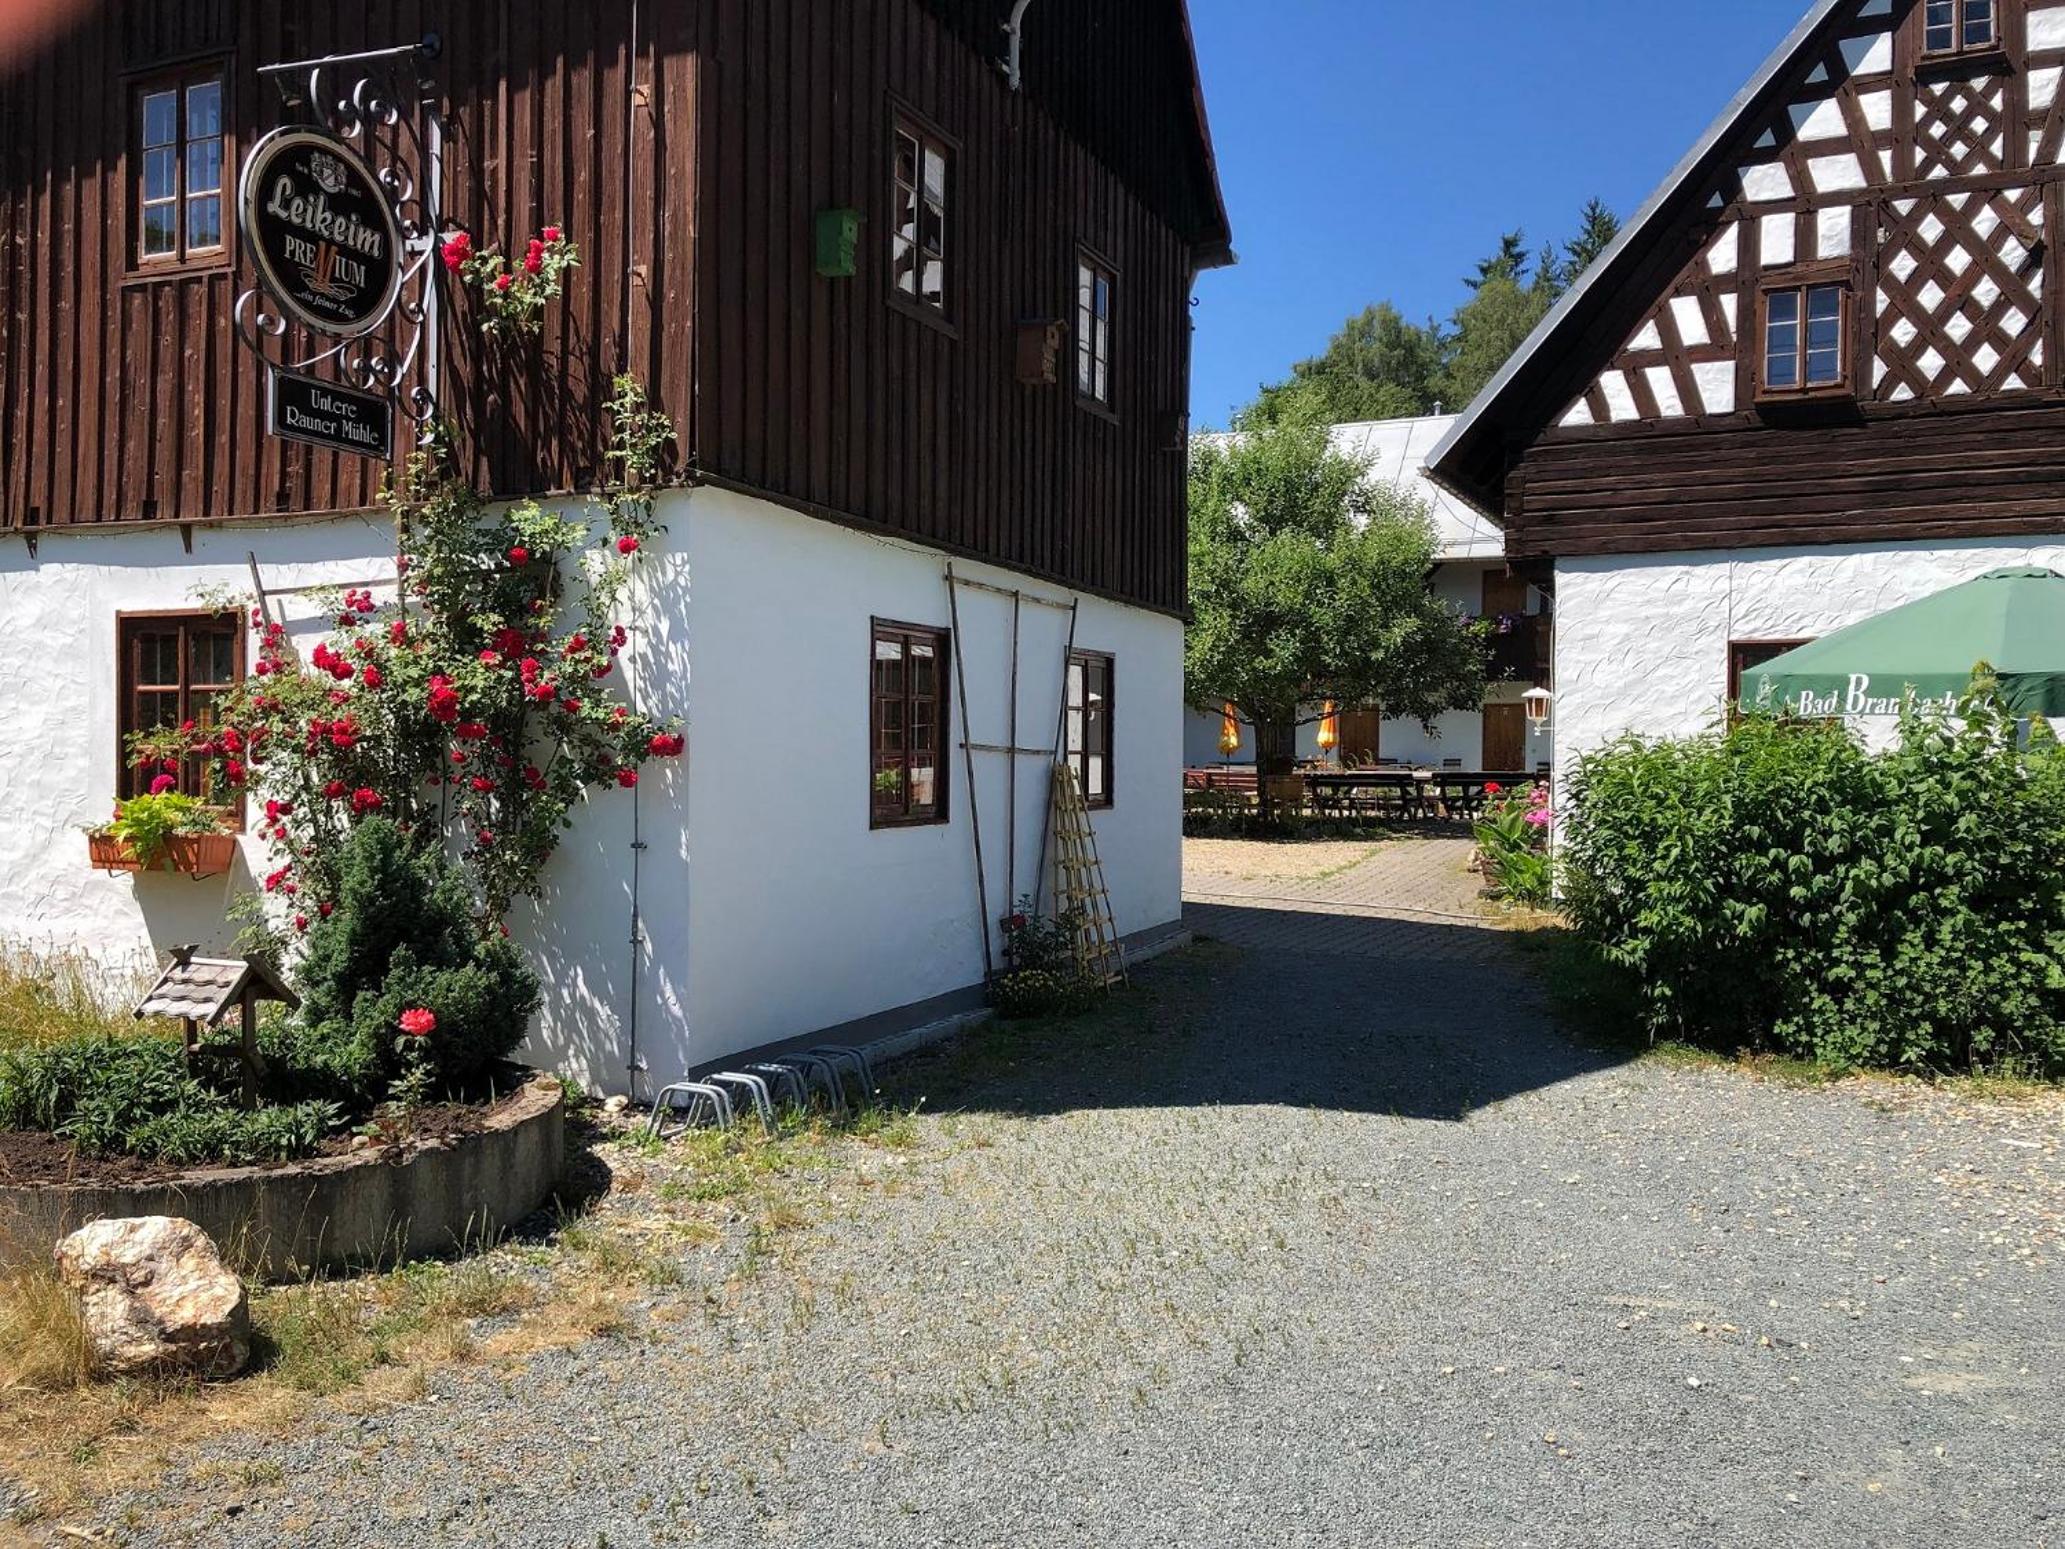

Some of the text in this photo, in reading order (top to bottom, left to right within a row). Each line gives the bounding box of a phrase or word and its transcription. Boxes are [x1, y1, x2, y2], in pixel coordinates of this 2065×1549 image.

[267, 175, 383, 259] Leikeim
[311, 389, 357, 418] Untere
[286, 405, 379, 445] Rauner Mühle
[1799, 690, 1839, 715] Bad
